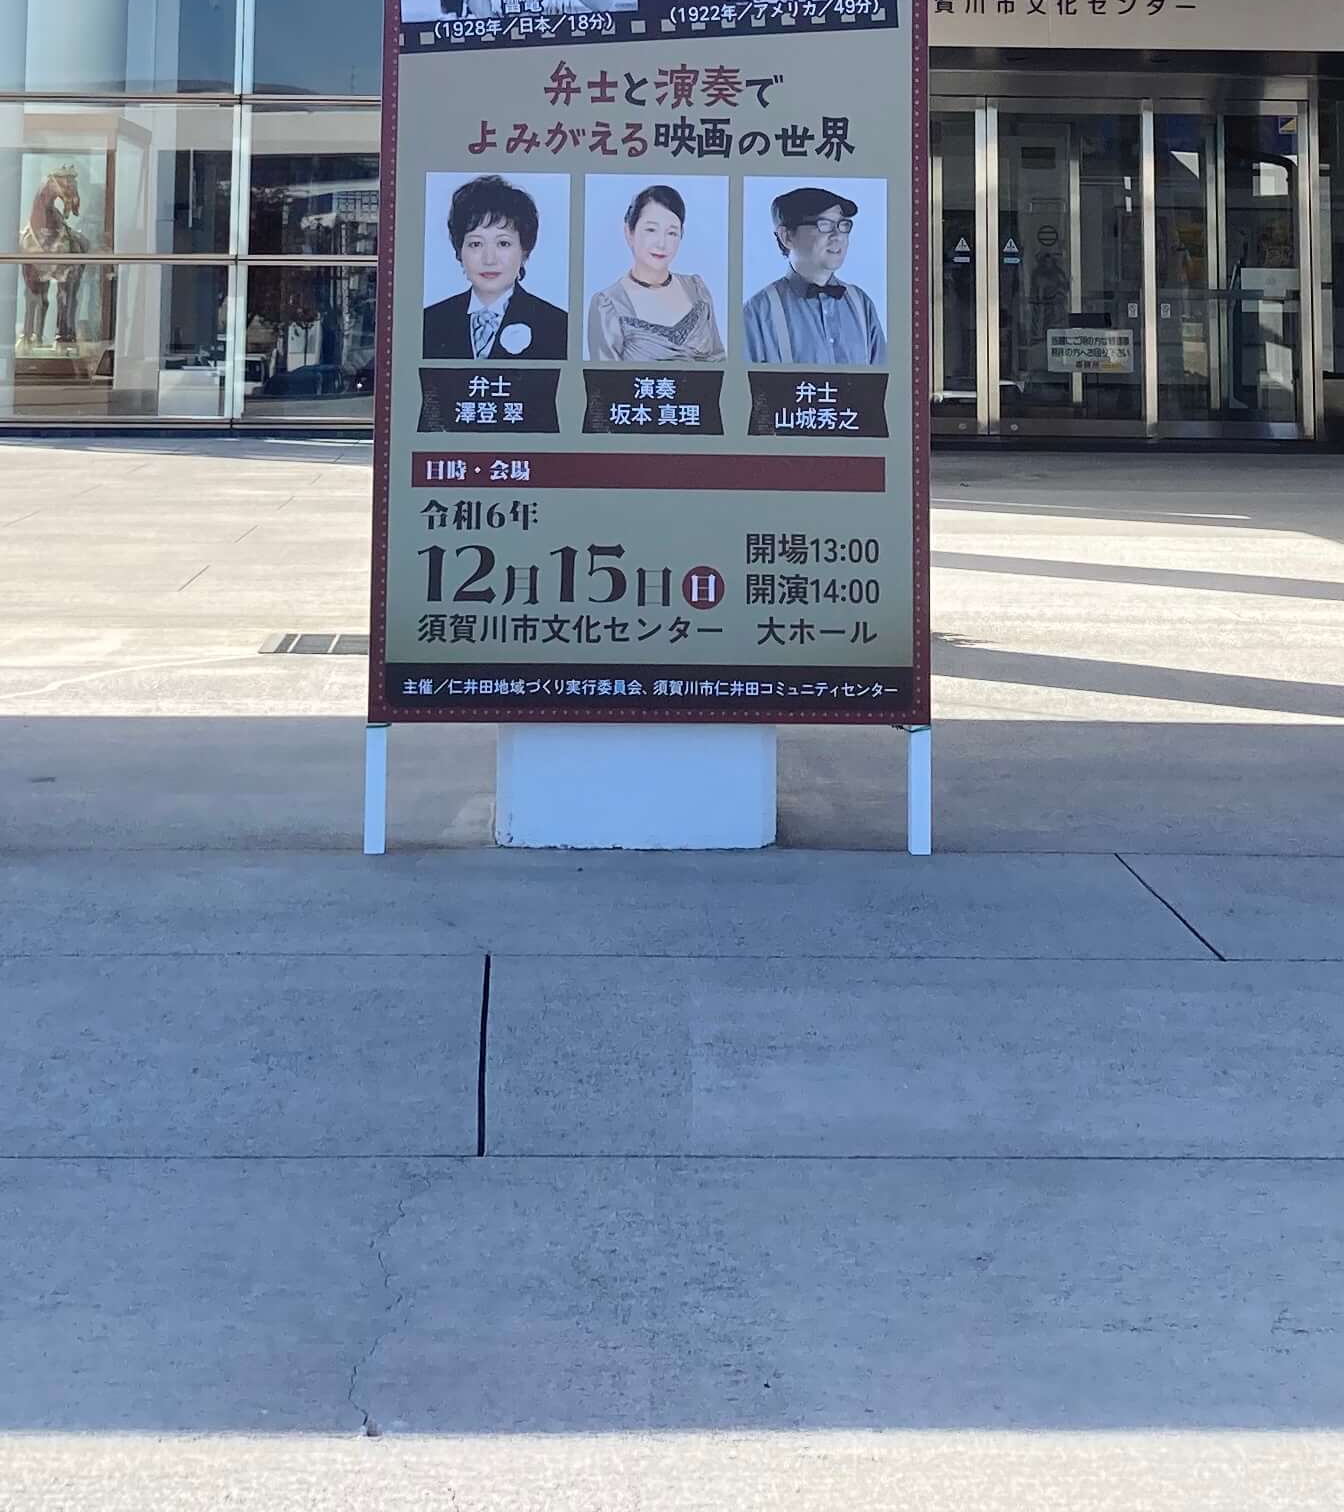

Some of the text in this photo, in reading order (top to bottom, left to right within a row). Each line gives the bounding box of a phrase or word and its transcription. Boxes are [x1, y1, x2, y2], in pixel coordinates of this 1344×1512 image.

[544, 61, 785, 109] 弁士と演奏で
[467, 117, 857, 162] よみがえる映画の世界
[468, 376, 511, 397] 弁士
[634, 377, 677, 399] 演奏
[796, 382, 838, 403] 弁士
[610, 403, 700, 425] 坂本 真理
[774, 409, 860, 430] 山城秀之
[420, 500, 539, 530] 令和6年
[746, 534, 880, 565] 開場13:00
[418, 543, 717, 607] 12月15日 日
[746, 574, 880, 606] 開演14:00
[417, 615, 878, 646] 須賀川市文化センター 大ホール
